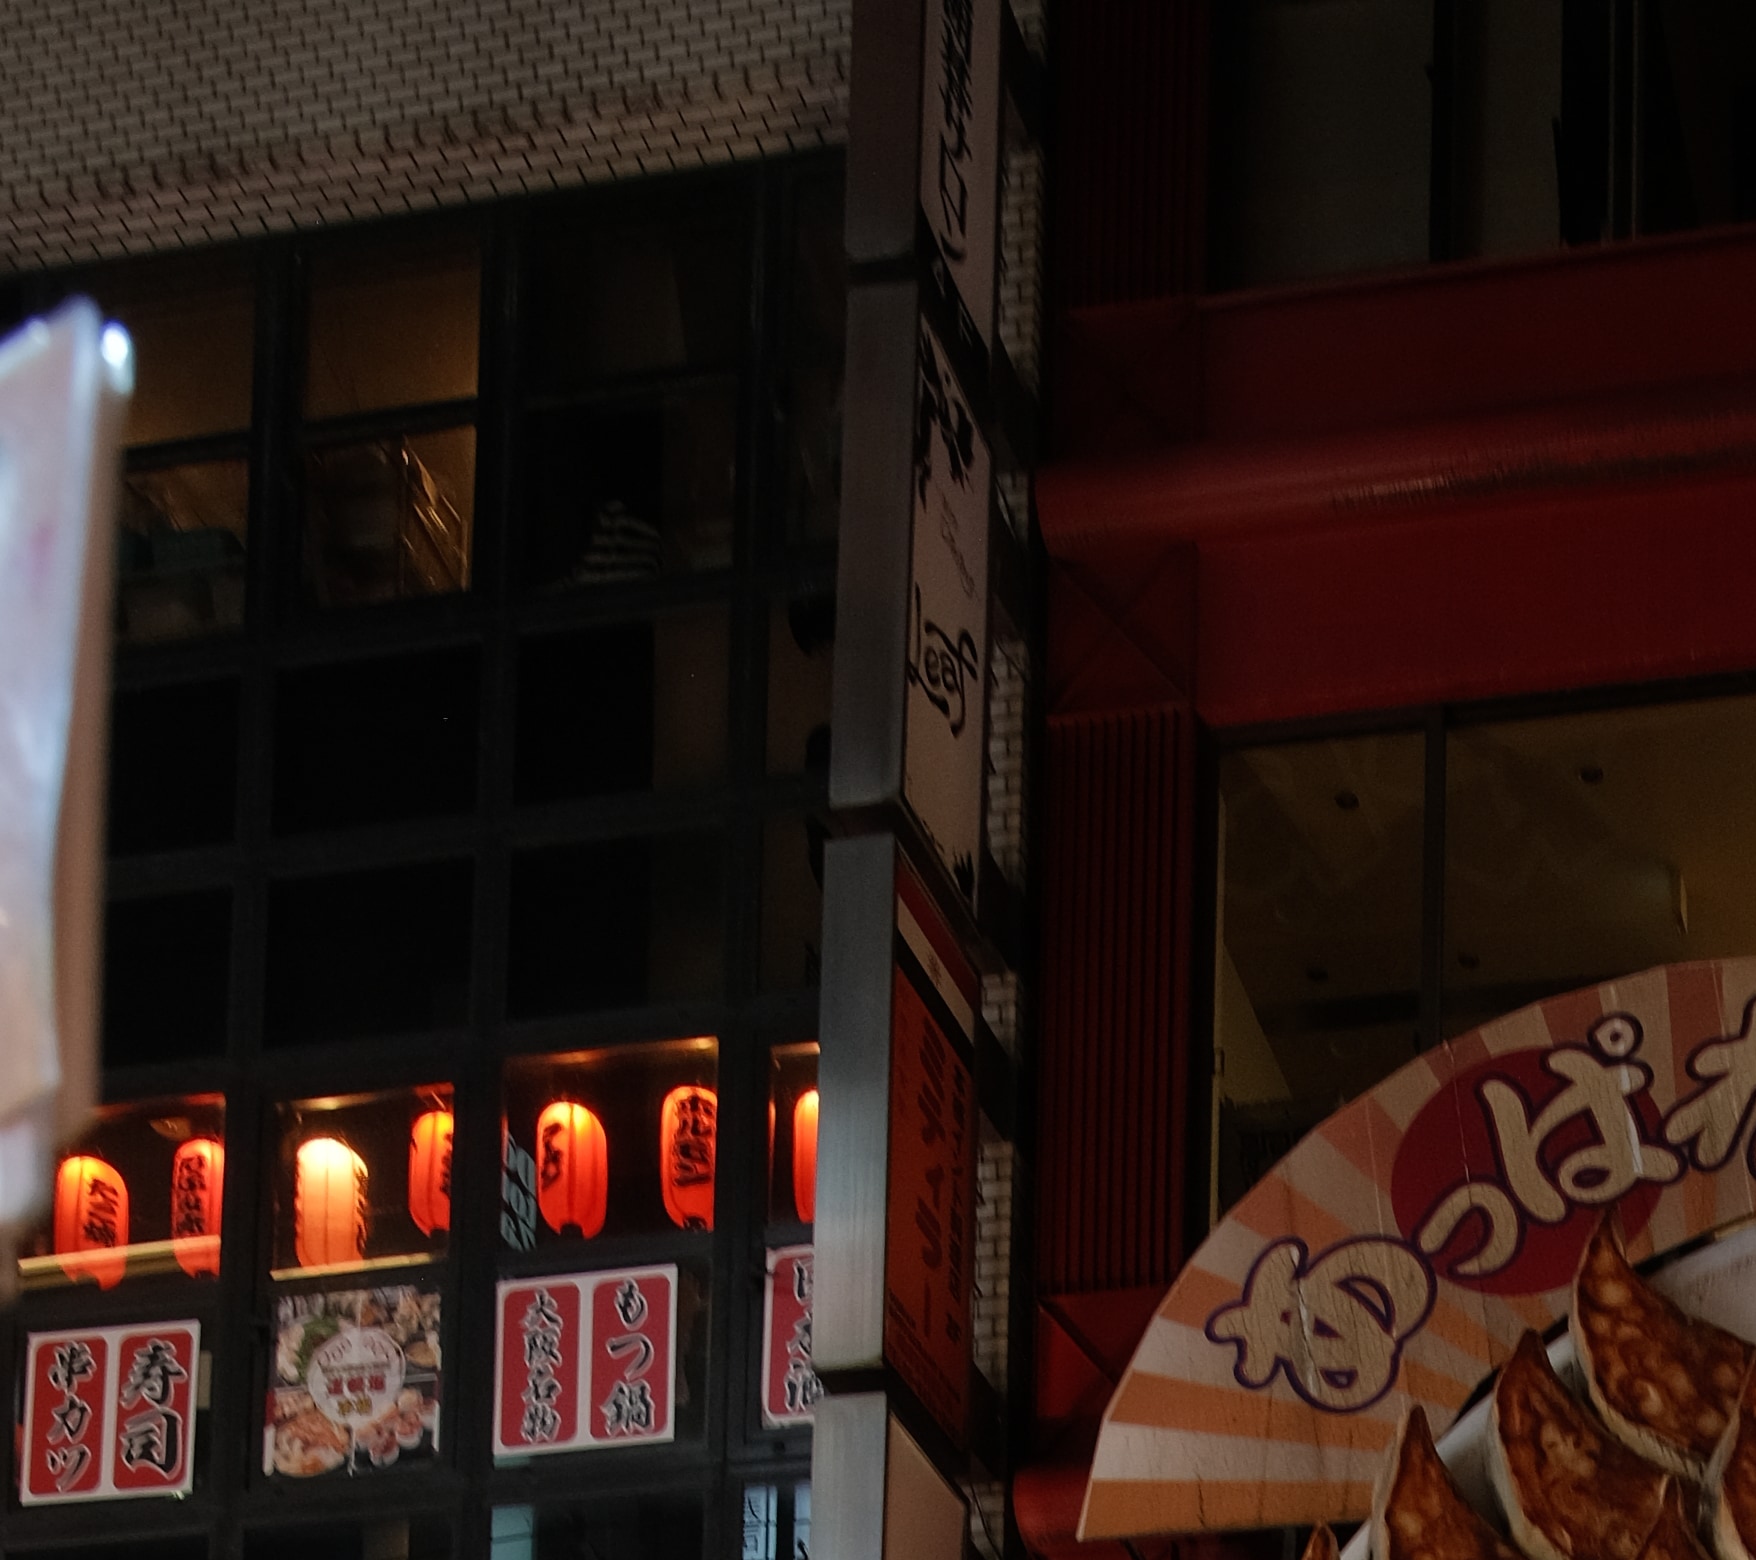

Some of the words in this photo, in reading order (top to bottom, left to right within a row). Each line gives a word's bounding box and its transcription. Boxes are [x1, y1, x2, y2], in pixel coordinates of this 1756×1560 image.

[46, 1340, 97, 1492] 串カツ
[120, 1338, 188, 1480] 寿司
[521, 1288, 563, 1443] 大阪名物
[600, 1277, 655, 1436] もつ鍋
